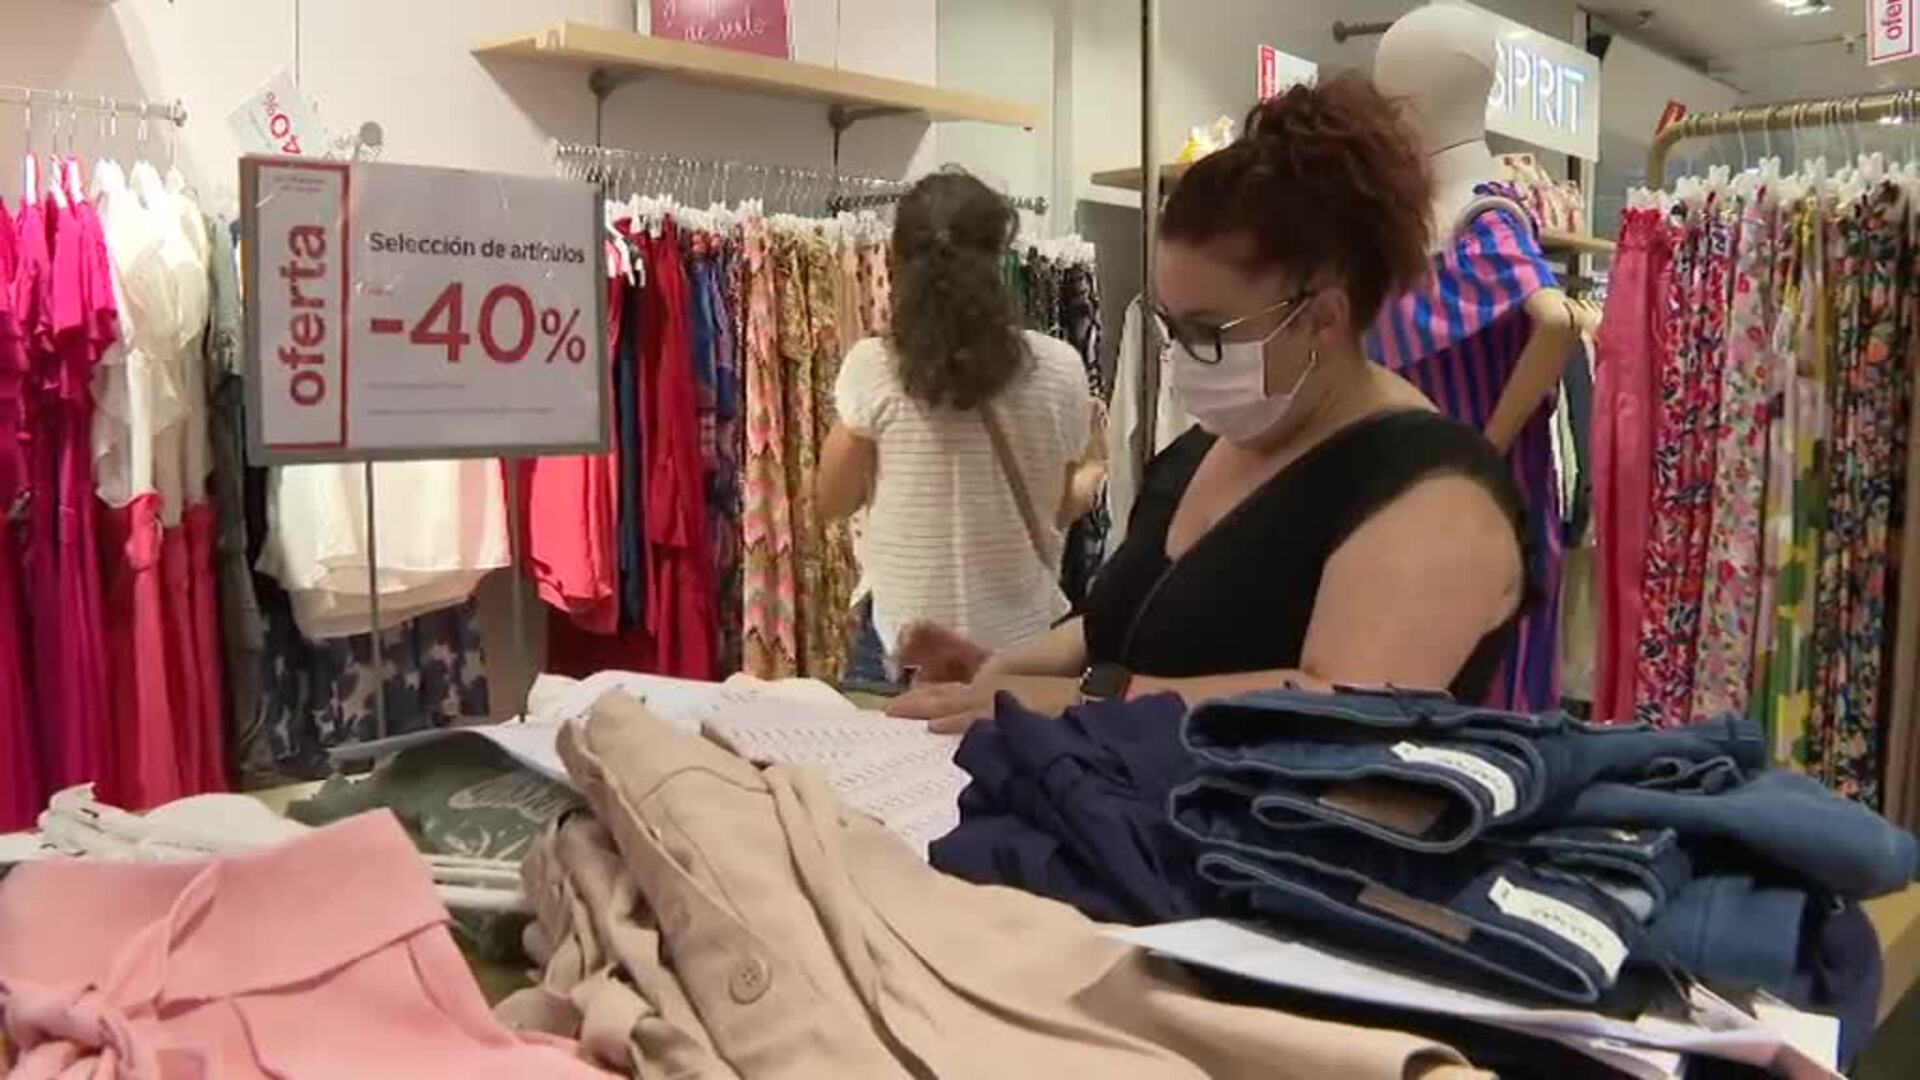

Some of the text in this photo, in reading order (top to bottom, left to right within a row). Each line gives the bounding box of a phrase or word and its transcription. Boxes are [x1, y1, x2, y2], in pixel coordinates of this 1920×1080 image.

[369, 231, 586, 264] Selección de artículos
[278, 224, 327, 407] oferta
[370, 281, 587, 366] -40%
